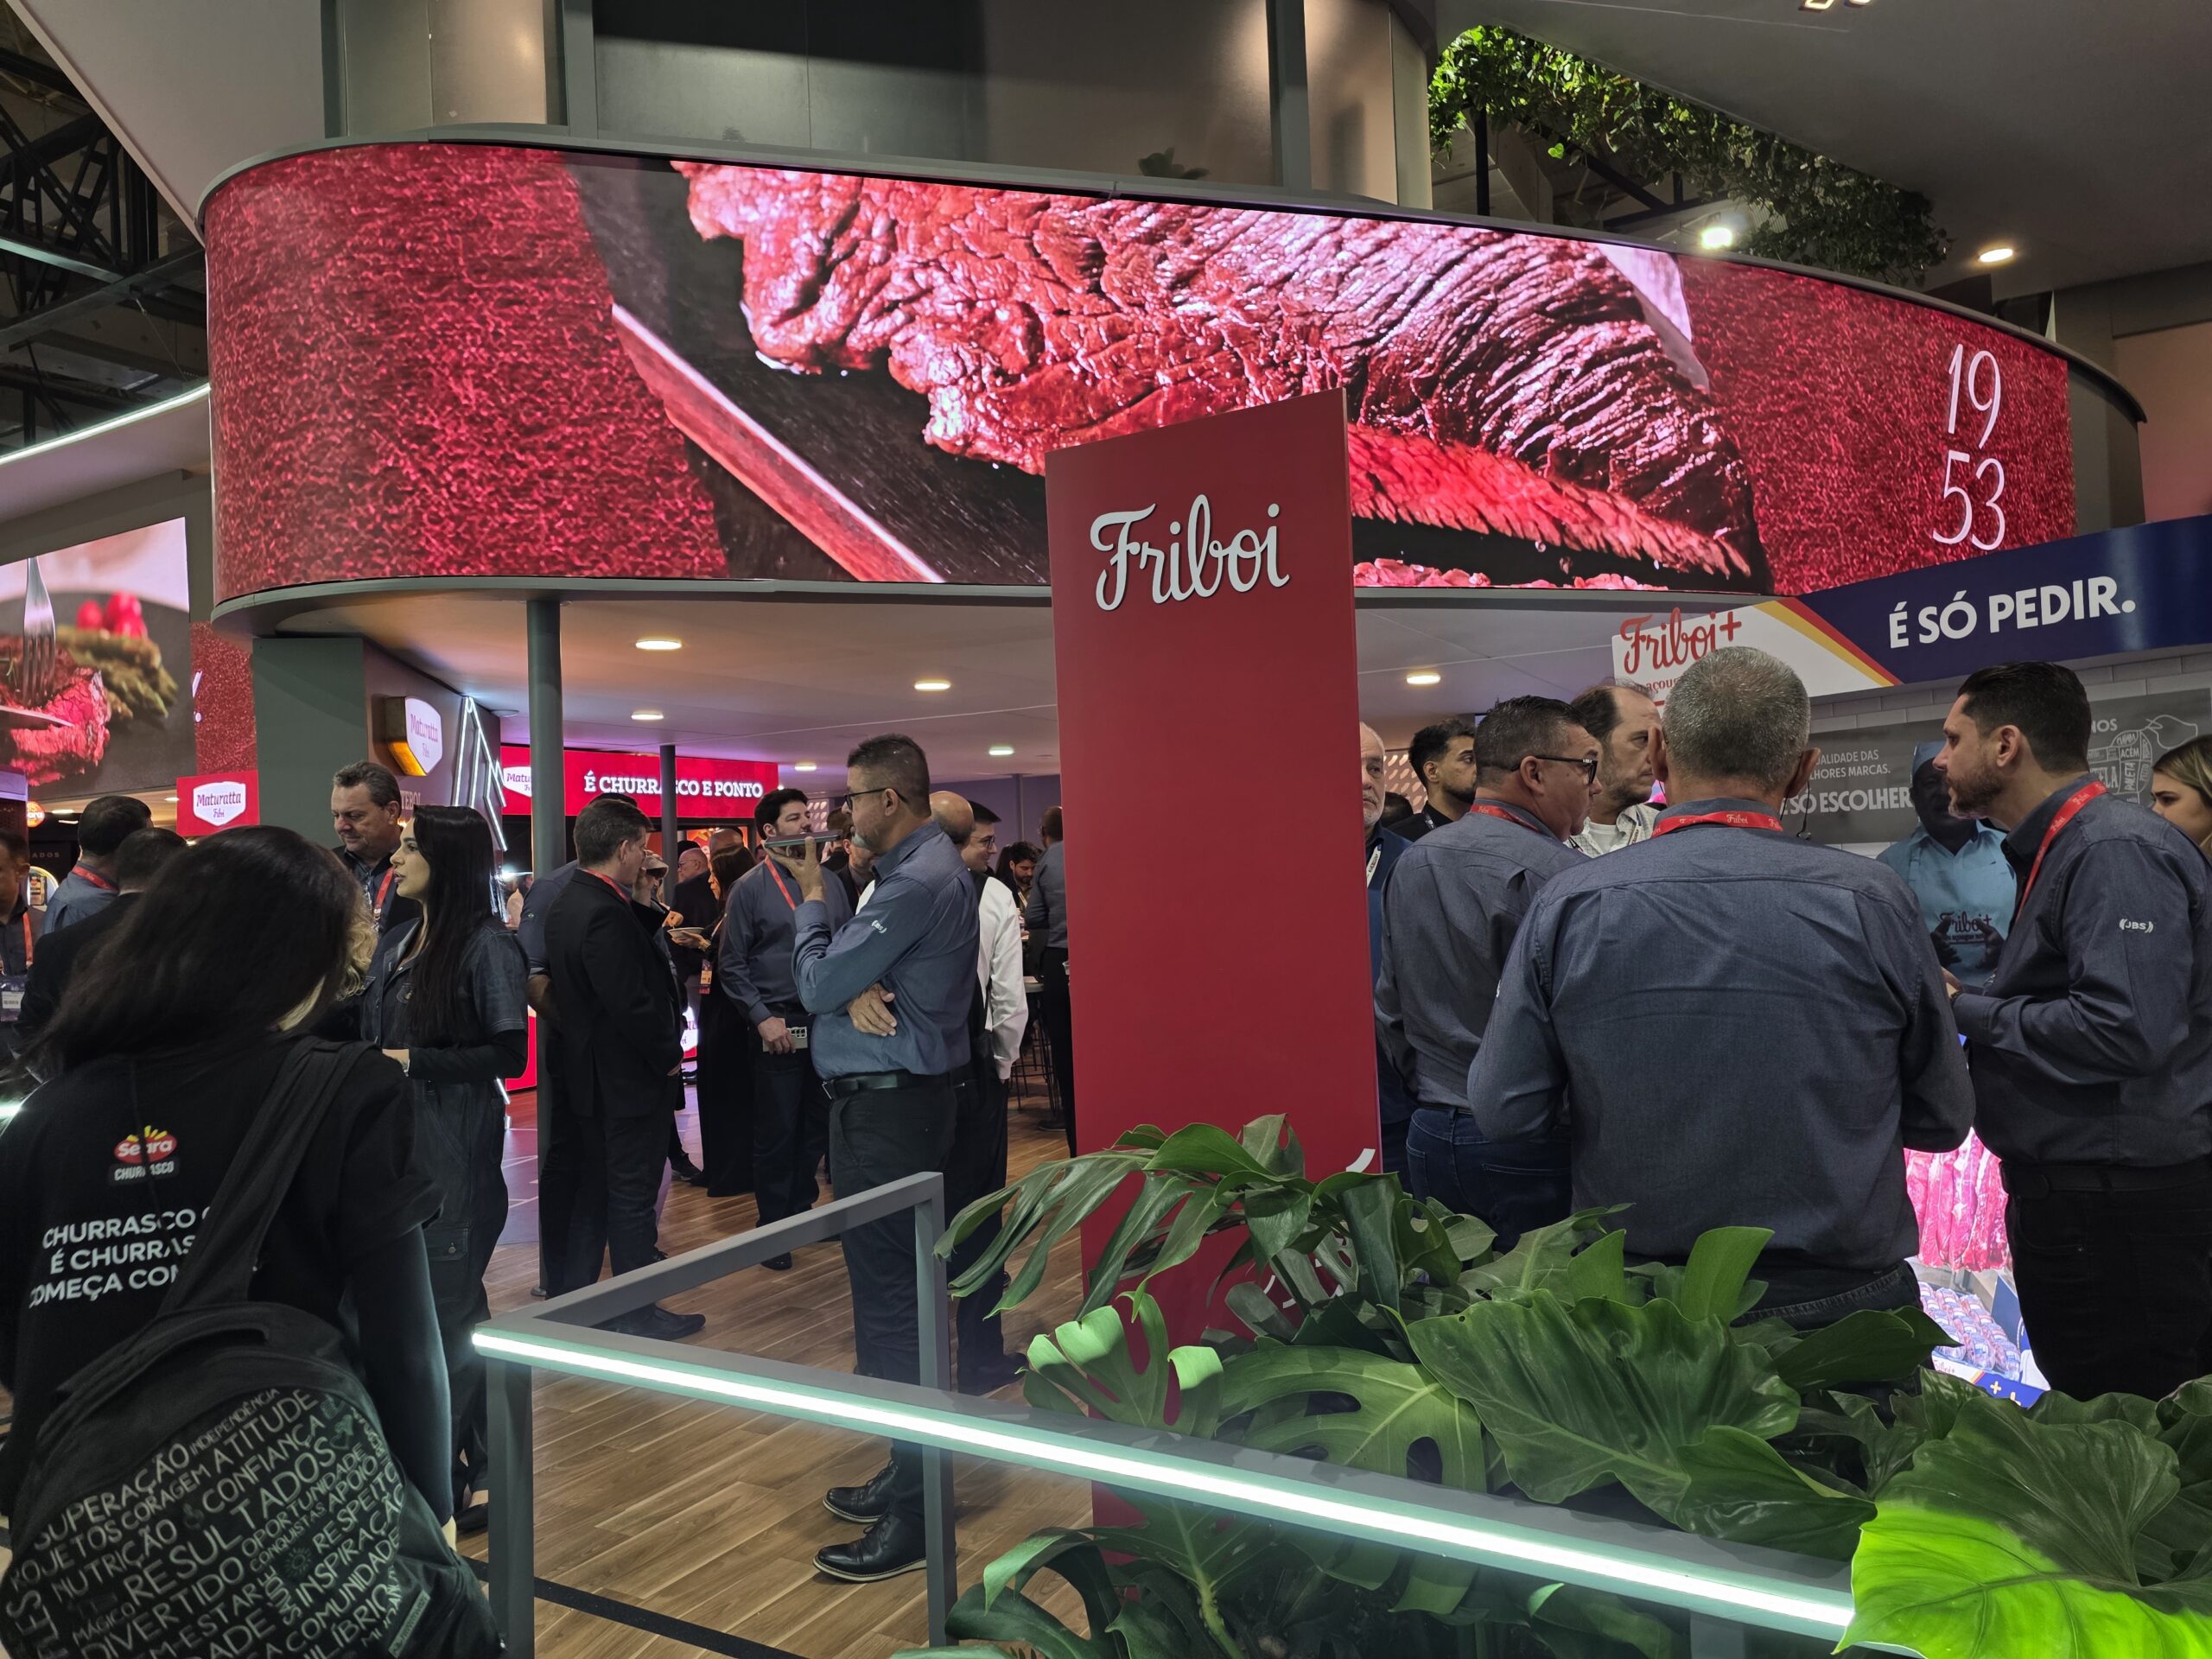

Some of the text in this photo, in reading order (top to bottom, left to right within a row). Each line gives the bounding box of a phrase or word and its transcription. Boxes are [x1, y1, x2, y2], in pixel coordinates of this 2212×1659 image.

[1948, 344, 2001, 449] 19
[1933, 449, 2005, 550] 53
[1090, 493, 1290, 611] Friboi
[1889, 575, 2136, 648] É SÓ PEDIR.
[1645, 678, 1680, 694] açou
[506, 772, 531, 782] Matu
[583, 769, 764, 798] É CHURRCO E PONTO
[1809, 764, 1891, 780] LHORES MARCAS.
[1815, 749, 1879, 766] UALIDADE DAS
[196, 791, 242, 807] Maturatta
[42, 1208, 196, 1249] CHURRASCO
[50, 1235, 196, 1274] É CHURRAS
[213, 1388, 319, 1474] ATITUDE
[10, 1519, 123, 1592] ROJETOS
[121, 1463, 212, 1530] CORAGEM
[201, 1414, 326, 1513] CONFIANÇA
[241, 1441, 366, 1557] OPORTUNIDADE
[312, 1459, 399, 1554] RESPEITO
[327, 1455, 378, 1513] APOIO
[50, 1518, 178, 1604] NUTRIÇÃO
